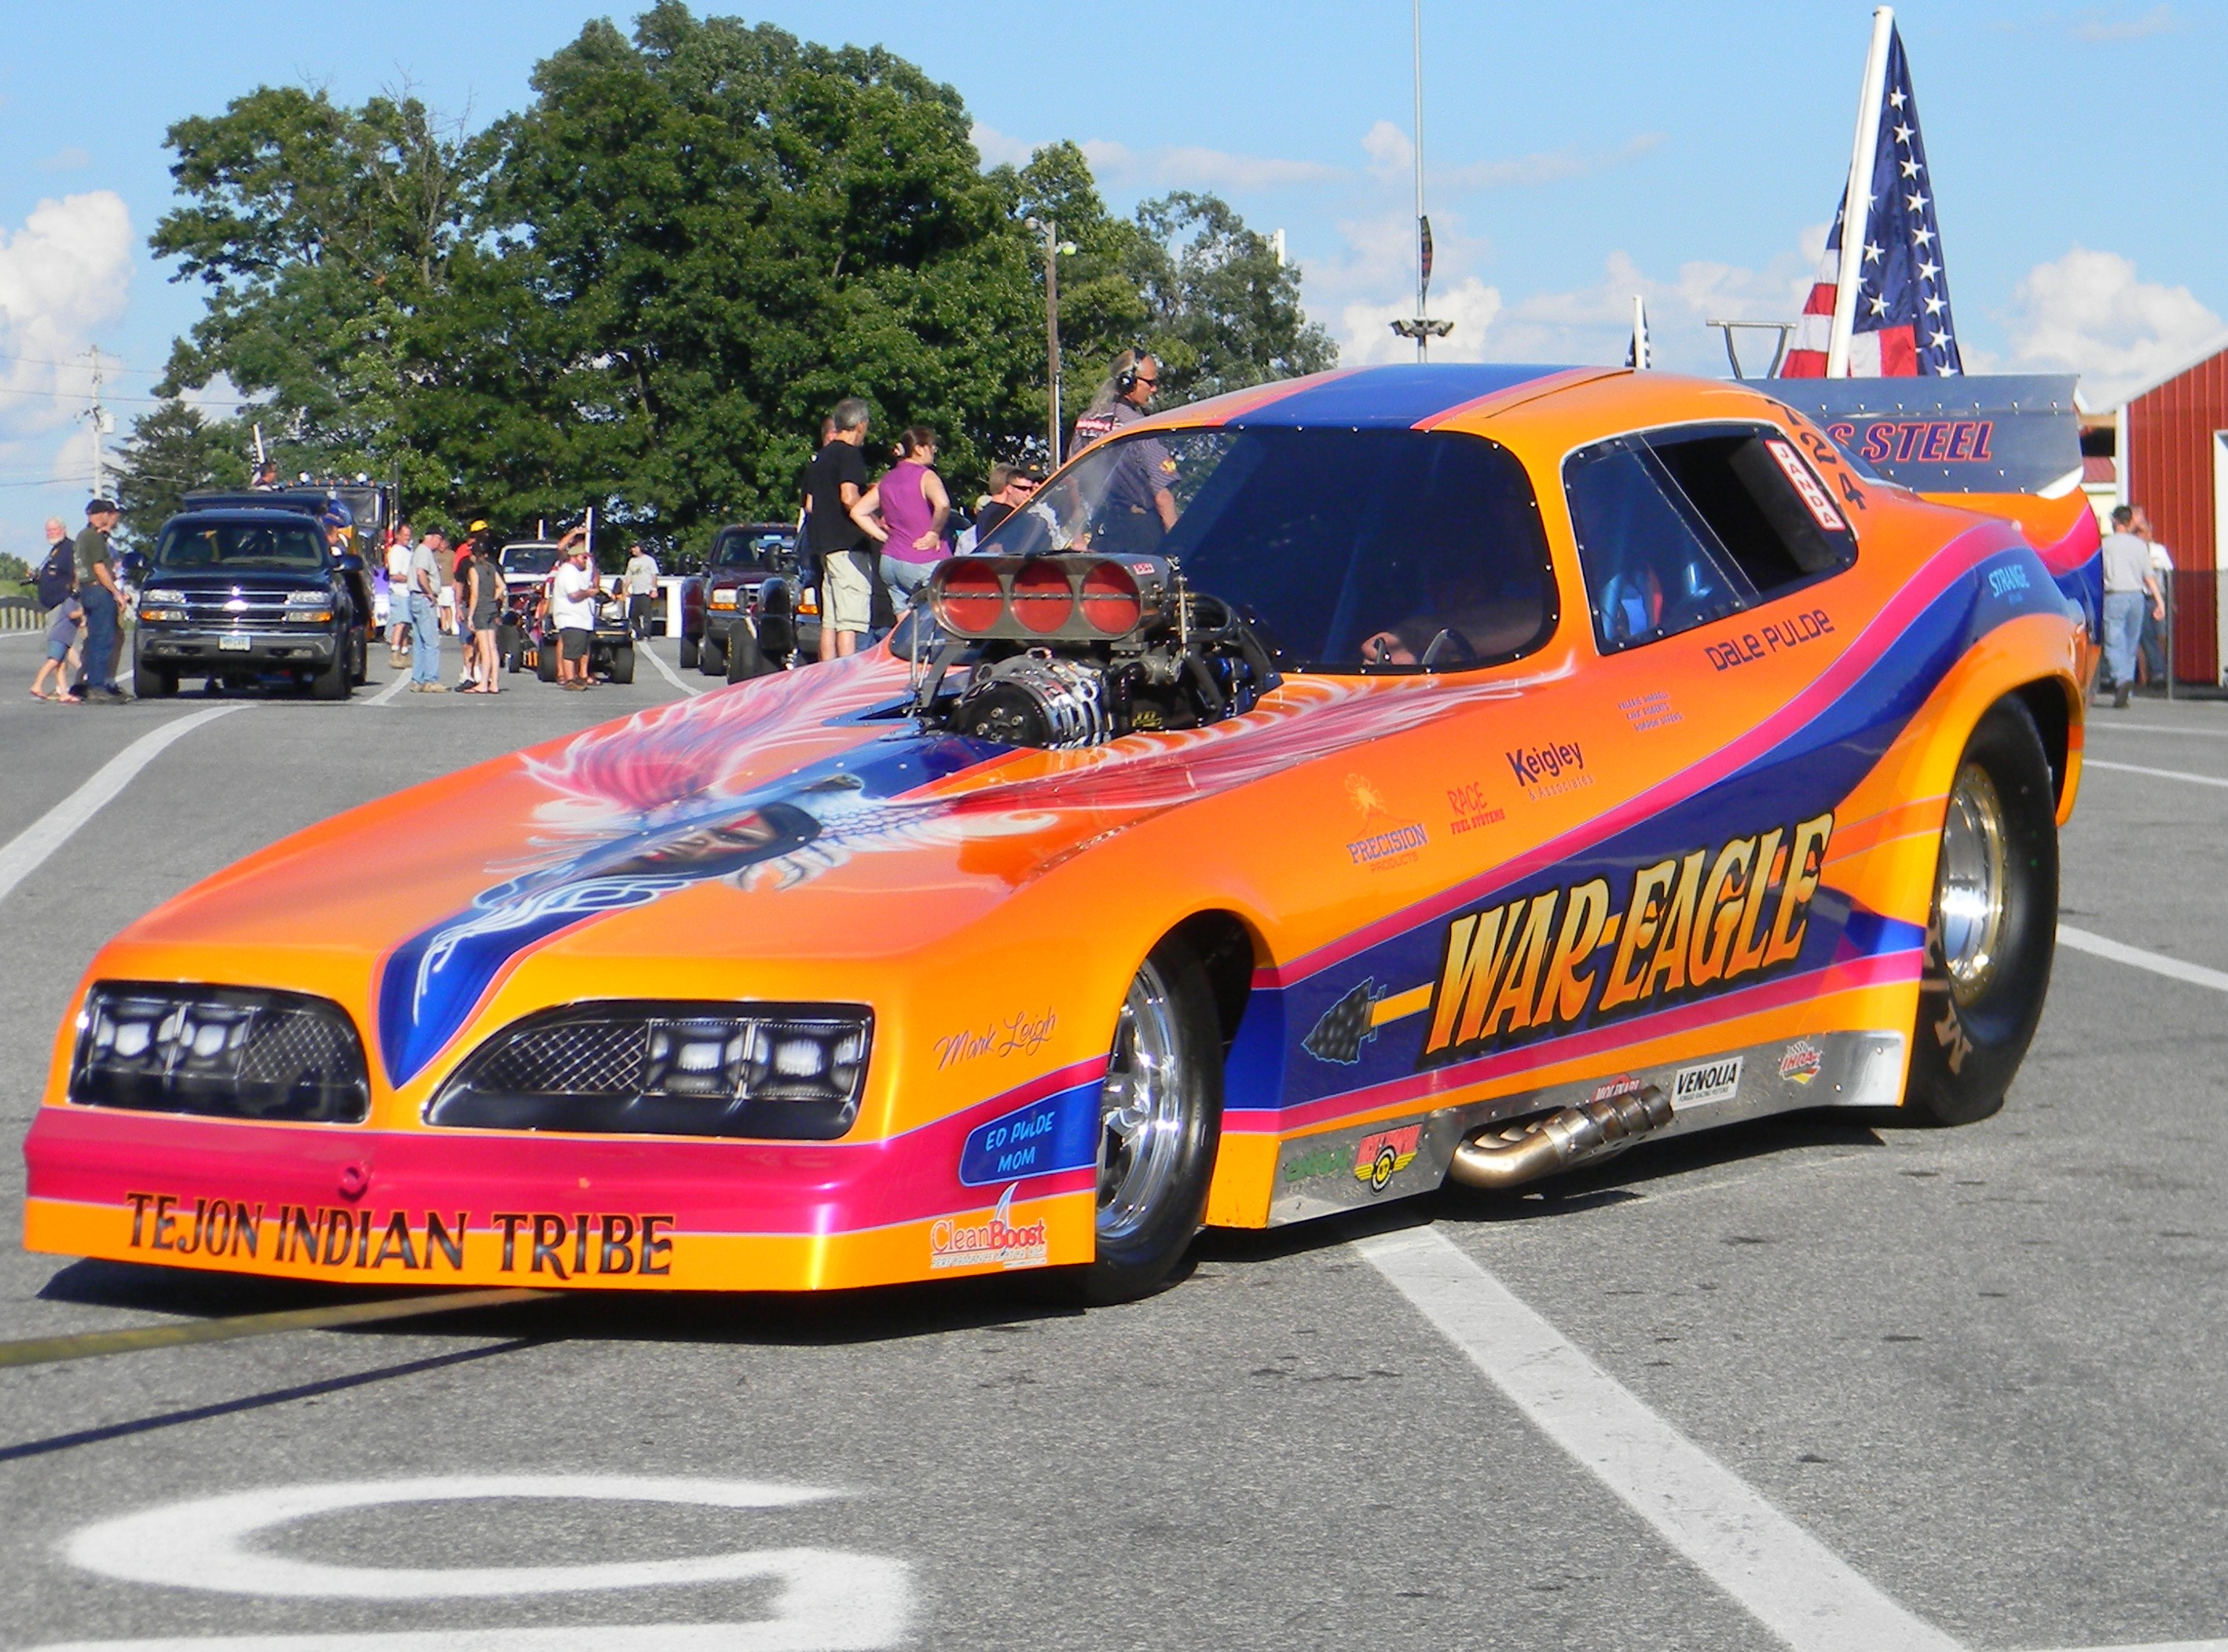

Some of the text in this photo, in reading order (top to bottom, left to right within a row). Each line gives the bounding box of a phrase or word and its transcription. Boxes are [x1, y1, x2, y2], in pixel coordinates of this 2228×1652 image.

[1861, 421, 1993, 463] STEEL
[1779, 446, 1840, 526] JANDA
[1505, 742, 1584, 787] Keigley
[1446, 782, 1488, 817] RACE
[1538, 775, 1594, 799] Associates
[1450, 808, 1505, 835] FUEL SYSTEMS
[1346, 822, 1428, 865] PRECISION
[1369, 851, 1419, 874] PRODUCTS
[1597, 812, 1836, 1013] EAGLE
[933, 1005, 1057, 1071] Mark Leigh
[1677, 1062, 1737, 1095] VENOLIA
[985, 1111, 1055, 1151] ED PULDE
[997, 1146, 1036, 1172] MOM
[126, 1192, 675, 1280] TEJON INDIAN TRIBE
[932, 1219, 1046, 1253] CleanBoost
